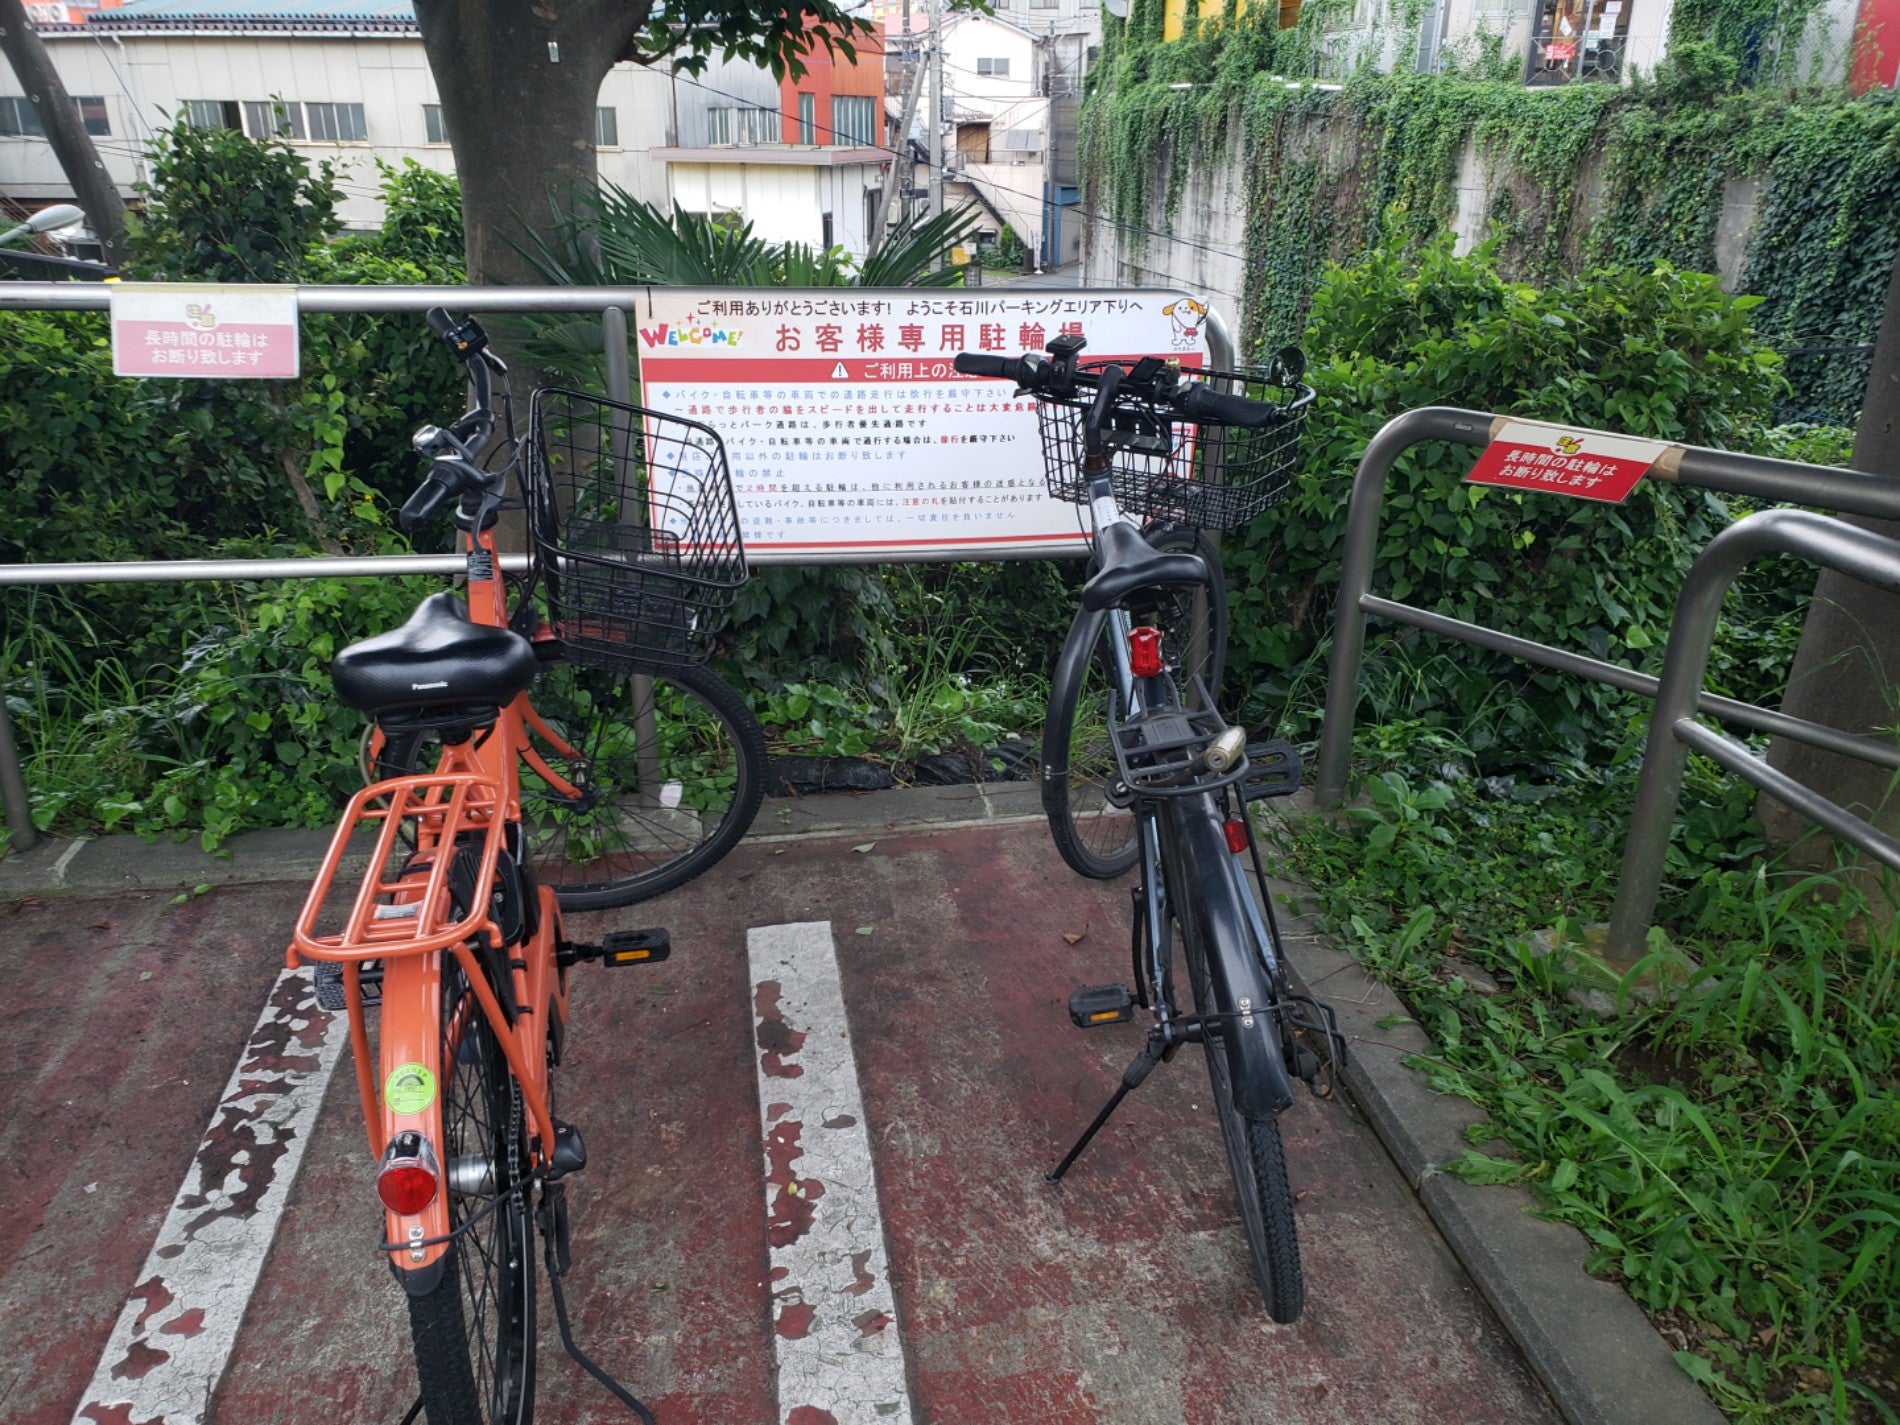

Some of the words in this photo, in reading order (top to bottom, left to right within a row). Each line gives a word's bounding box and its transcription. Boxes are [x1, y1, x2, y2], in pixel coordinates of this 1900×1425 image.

[907, 298, 1143, 316] ようこそ石川パーキングエリア下りへ
[144, 330, 269, 348] 長時間の駐輪は
[639, 322, 744, 348] WELCOME!
[152, 349, 263, 366] お断り致します
[1505, 450, 1618, 477] 長時間の駐輪は
[1499, 464, 1602, 488] お断り致します
[412, 680, 448, 691] Panasonic
